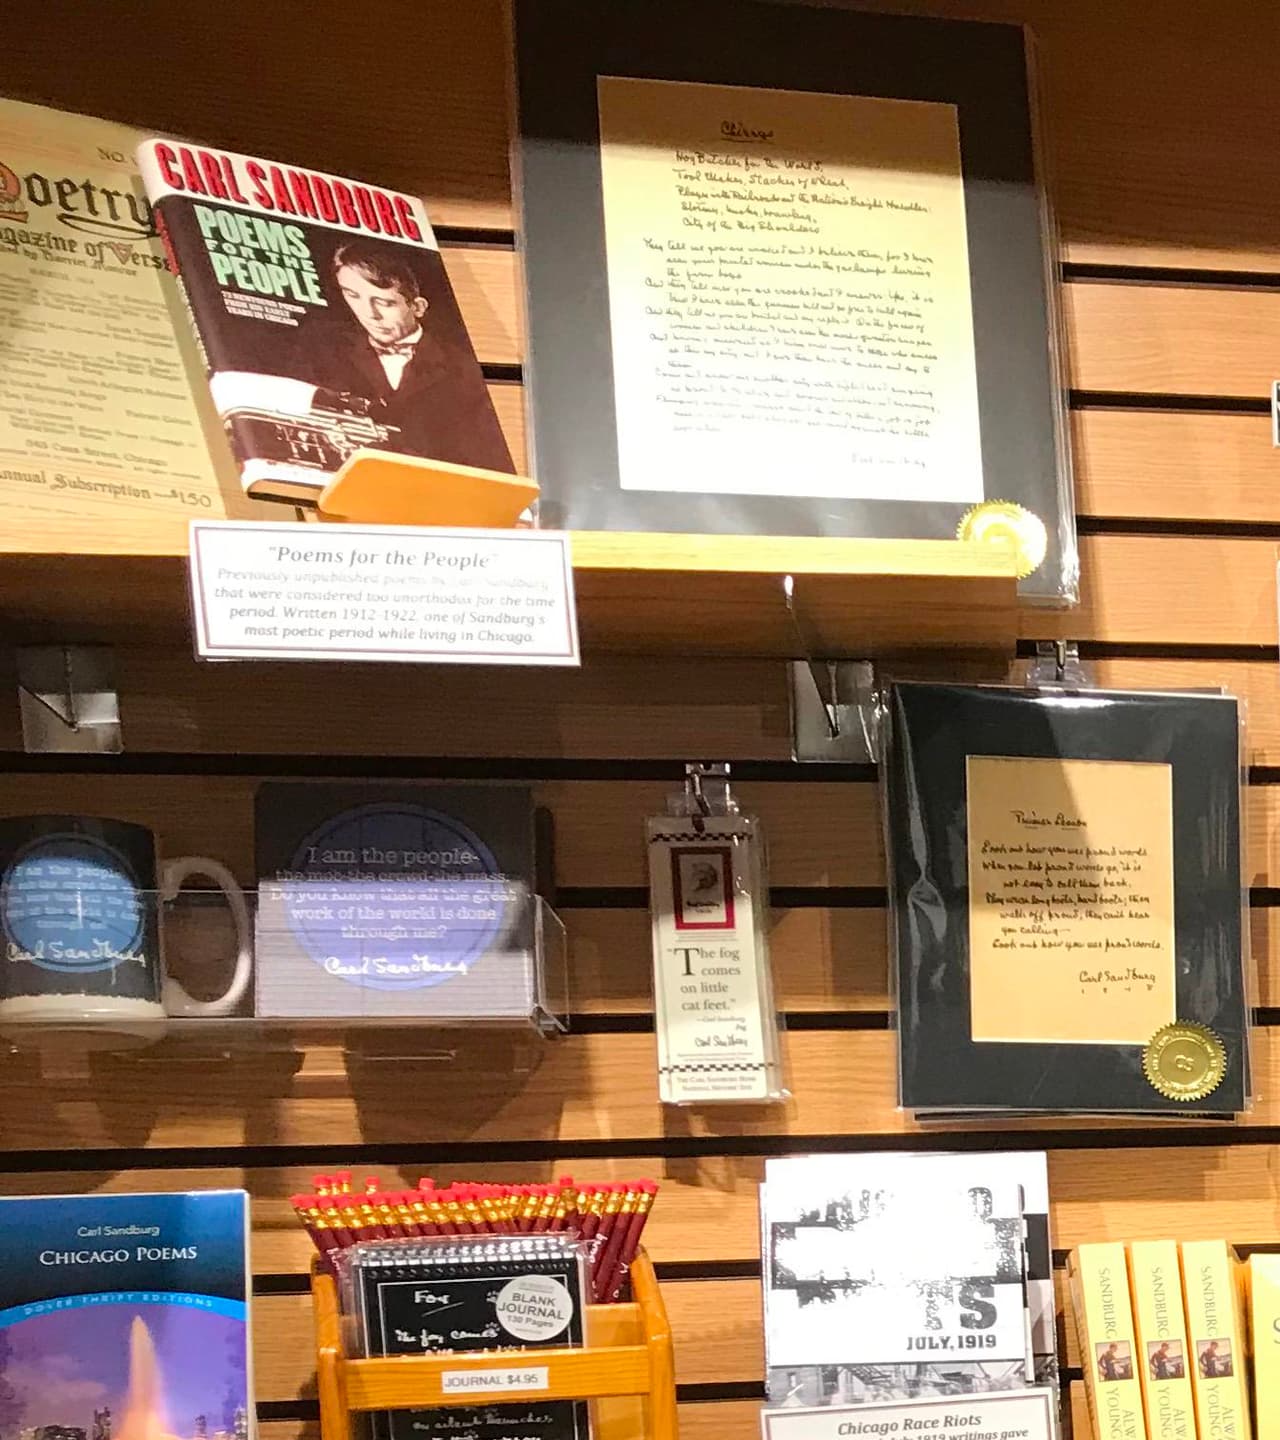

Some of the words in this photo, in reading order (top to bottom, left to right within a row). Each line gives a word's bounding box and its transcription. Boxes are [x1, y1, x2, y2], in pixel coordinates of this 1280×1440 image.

[154, 142, 249, 205] CARL
[245, 161, 424, 242] SANDBURG
[194, 205, 311, 259] POEMS
[204, 240, 256, 264] FOR
[267, 253, 316, 273] THE
[208, 252, 327, 306] PEOPLE
[720, 947, 740, 961] fog
[701, 967, 740, 975] comes
[680, 984, 696, 993] on
[701, 982, 728, 993] little
[682, 1001, 700, 1011] cat
[78, 1225, 100, 1237] Carl
[103, 1224, 159, 1239] Sandburg
[512, 1292, 555, 1307] BLANK
[497, 1301, 564, 1321] JOURNAL
[907, 1335, 954, 1350] JULY,
[958, 1334, 997, 1348] 1919
[444, 1374, 502, 1387] JOURNAL
[507, 1374, 538, 1385] $4.95
[838, 1420, 898, 1436] Chicago
[903, 1417, 939, 1430] Race
[944, 1414, 982, 1427] Riots
